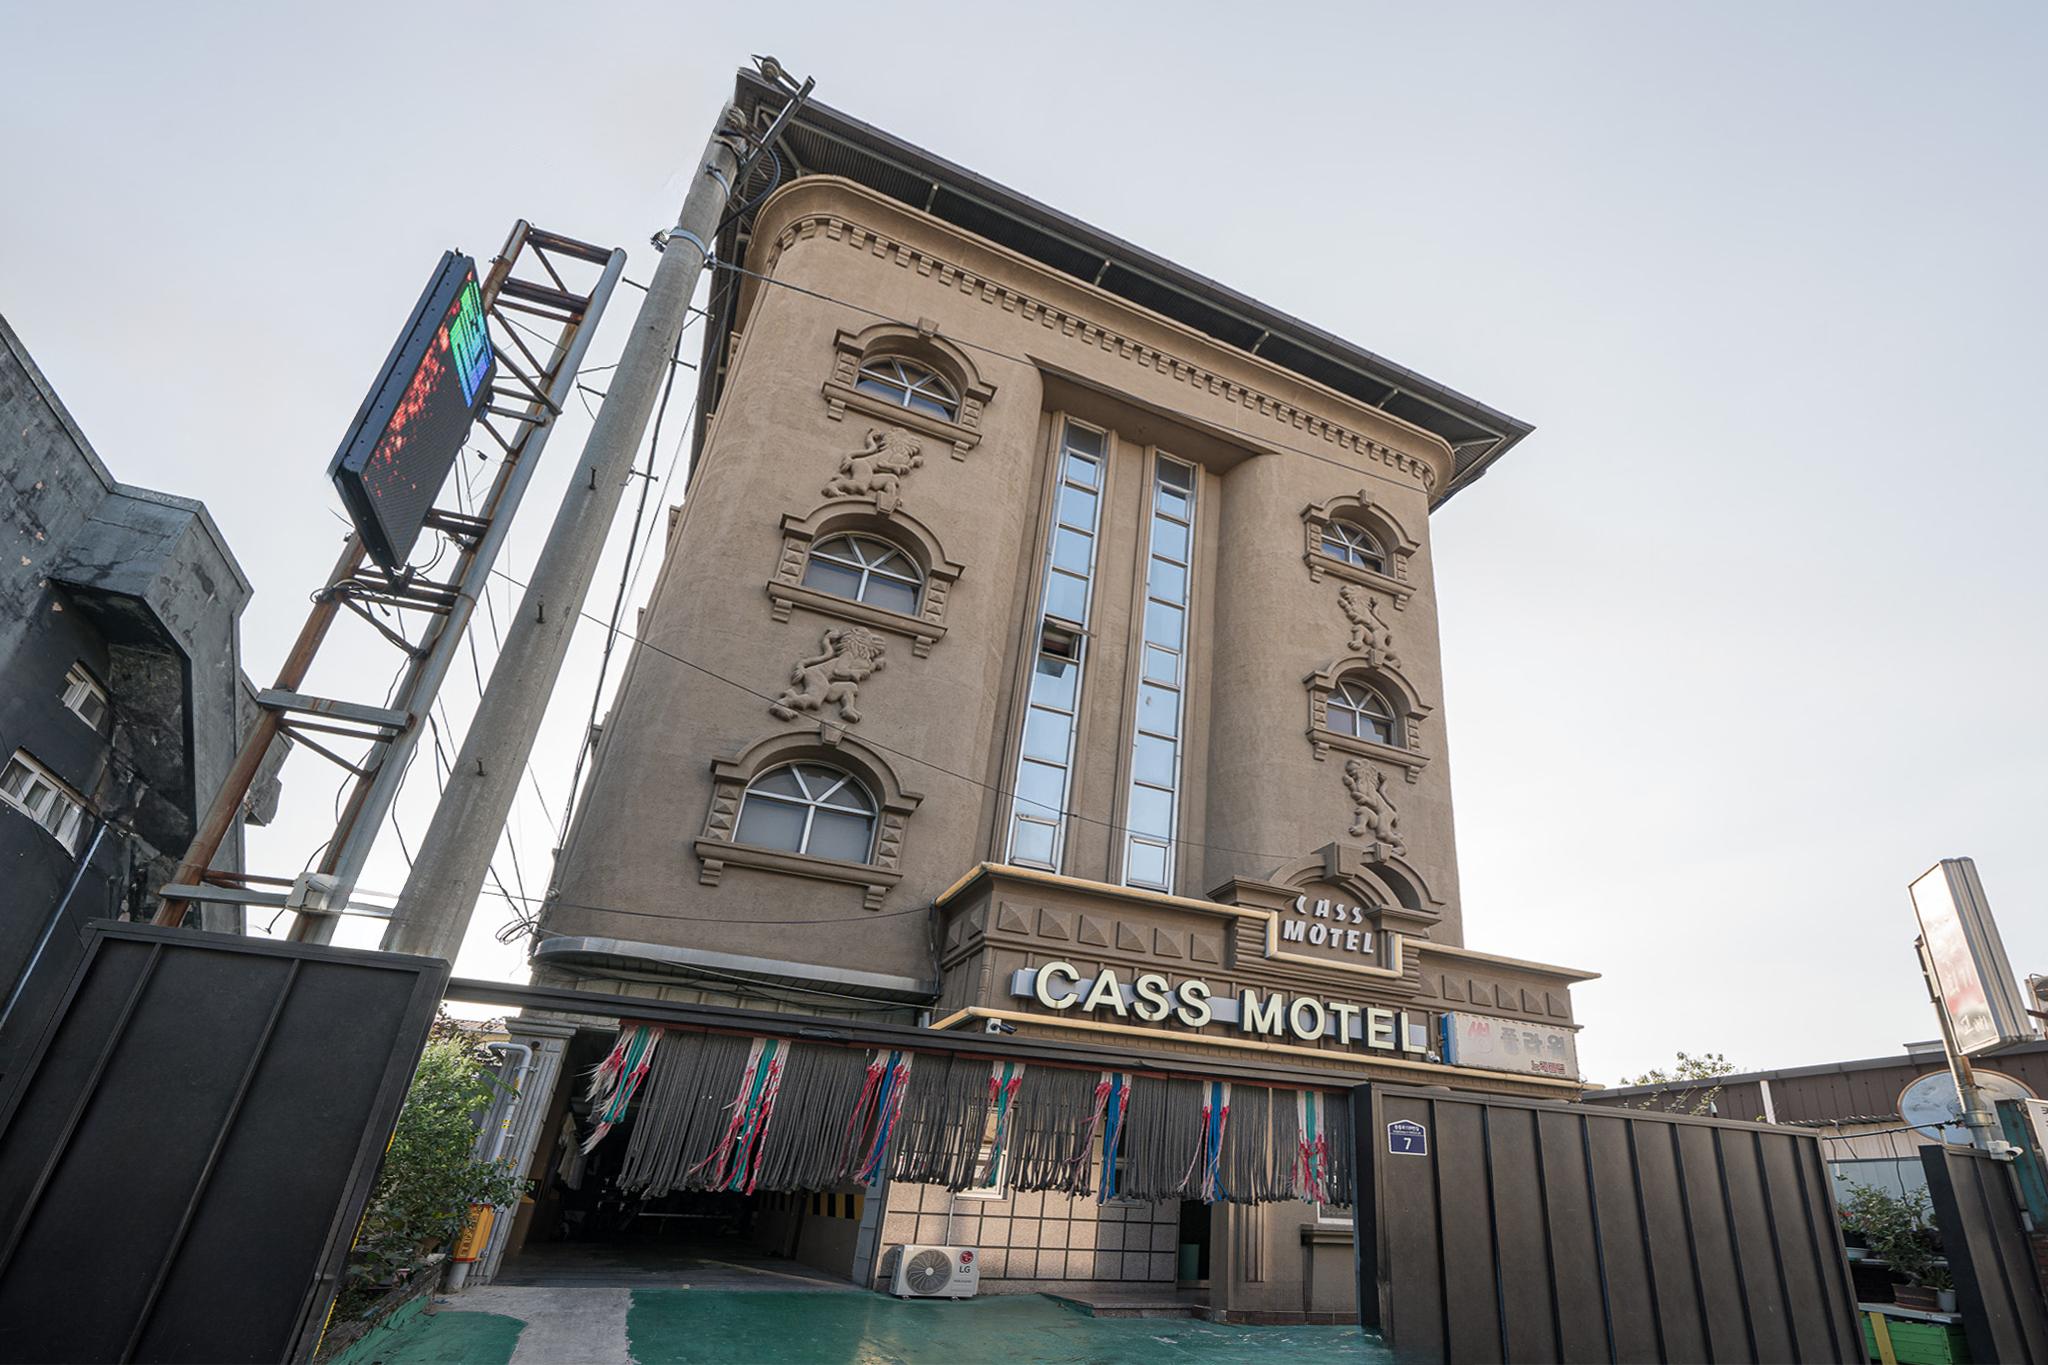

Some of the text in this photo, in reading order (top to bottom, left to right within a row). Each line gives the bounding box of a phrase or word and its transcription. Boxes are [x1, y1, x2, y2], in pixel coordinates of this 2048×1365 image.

[1295, 893, 1364, 925] CASS
[1282, 919, 1375, 954] MOTEL
[1033, 961, 1428, 1054] CASS MOTEL
[1404, 1138, 1412, 1150] 7
